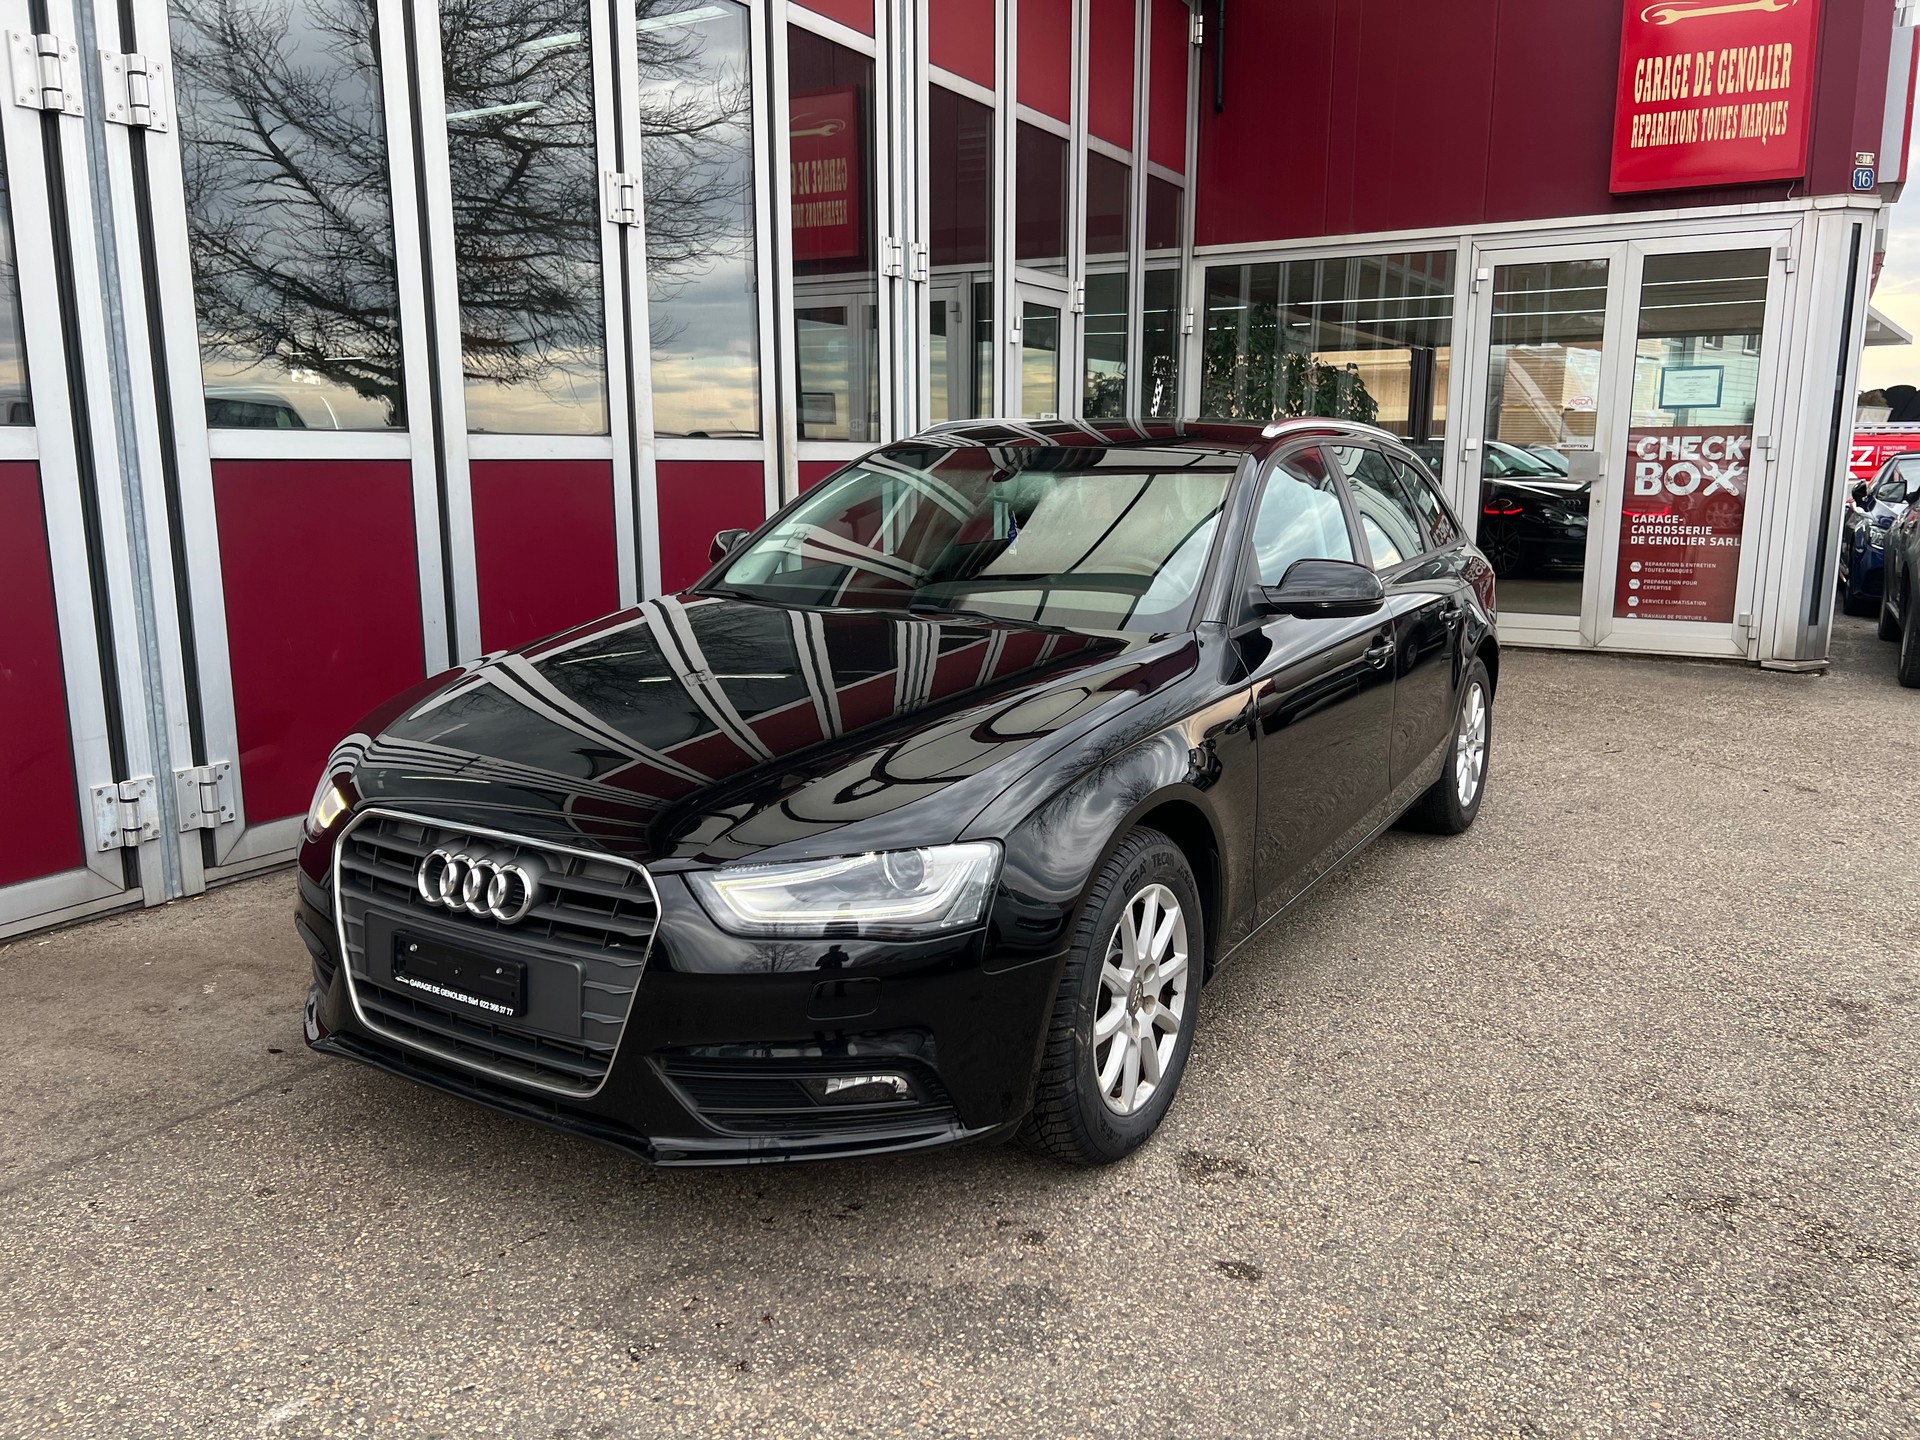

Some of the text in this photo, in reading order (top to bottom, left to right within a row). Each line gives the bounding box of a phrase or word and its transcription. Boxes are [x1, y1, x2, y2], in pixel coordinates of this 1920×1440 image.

[1634, 43, 1792, 103] GARAGE DE GENOLIER
[1631, 101, 1788, 148] REPARATIONS TOUTES MARQUES
[1857, 171, 1871, 187] 16
[1636, 435, 1747, 461] CHECK
[1634, 461, 1744, 496] BOX
[1631, 525, 1713, 535] CARROSSERIE
[1632, 514, 1684, 524] GARAGE-
[1630, 536, 1740, 547] DE GENOLIER SARL
[410, 979, 432, 992] GARAGE
[432, 985, 441, 994] DE
[440, 988, 468, 1003] GENOLIER
[479, 1000, 490, 1009] 022
[506, 1007, 514, 1017] 77
